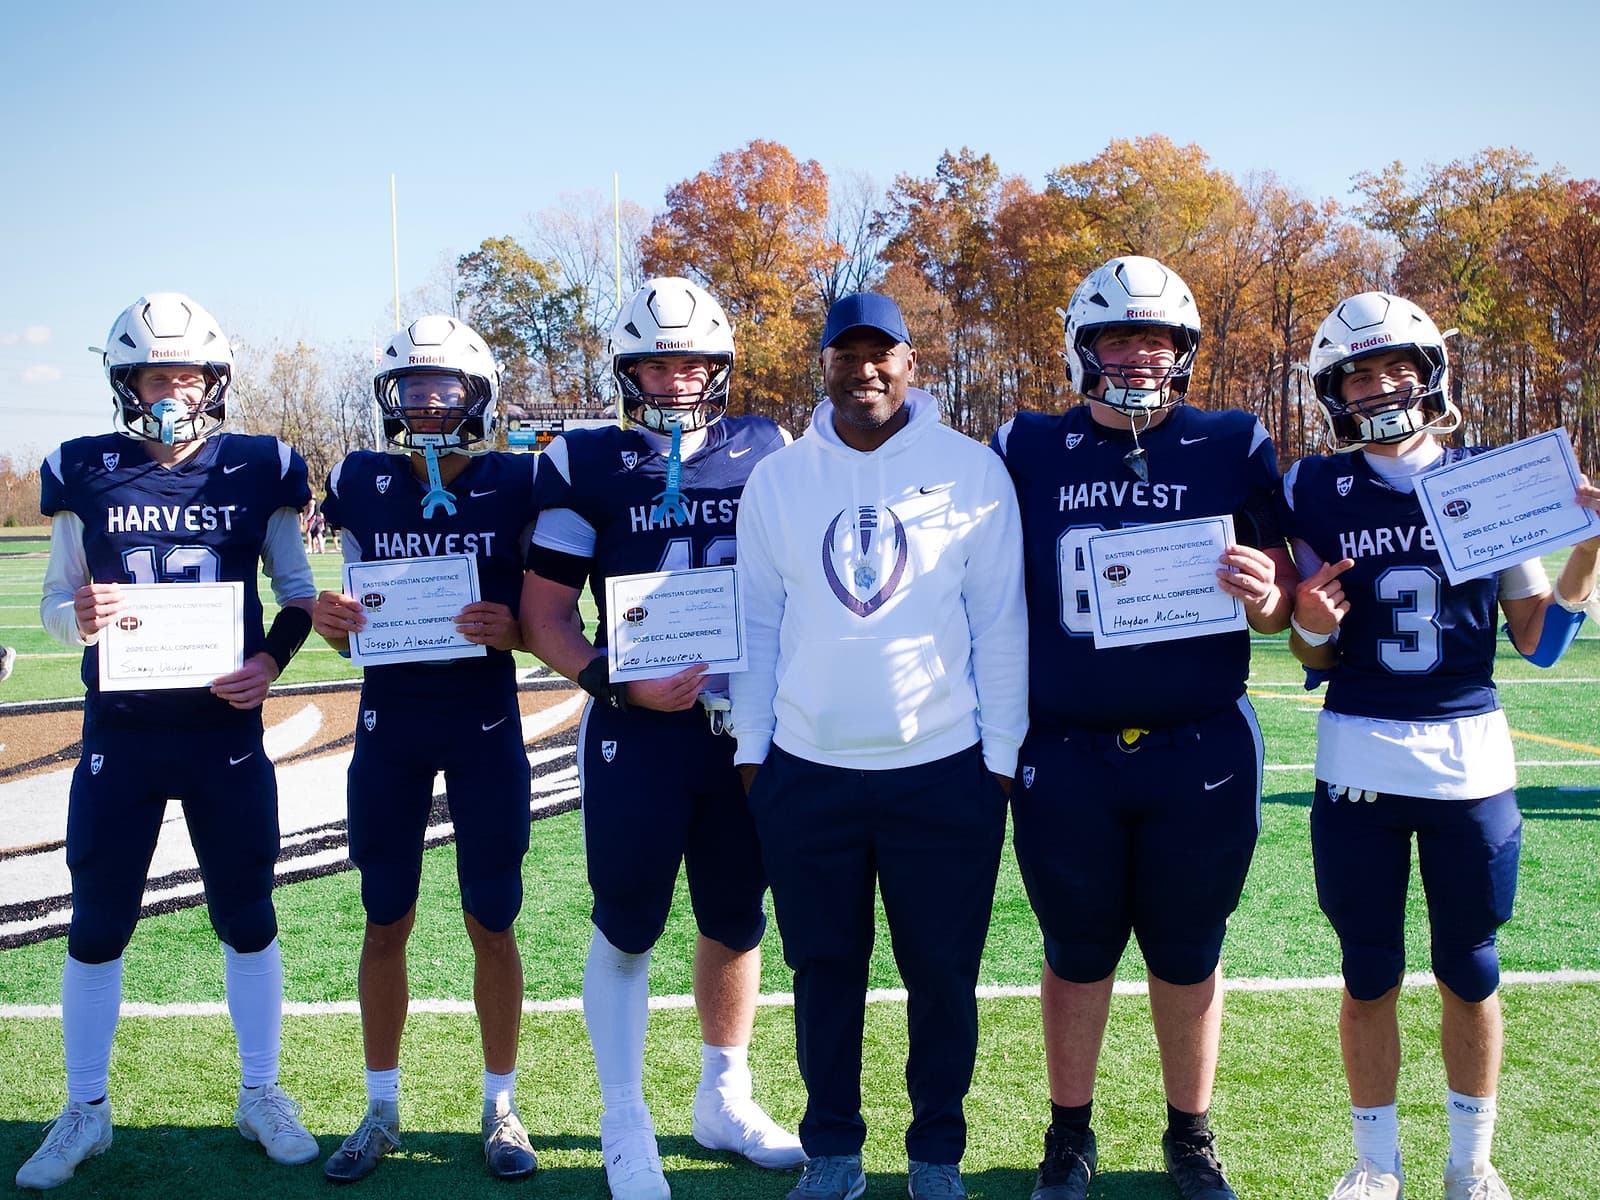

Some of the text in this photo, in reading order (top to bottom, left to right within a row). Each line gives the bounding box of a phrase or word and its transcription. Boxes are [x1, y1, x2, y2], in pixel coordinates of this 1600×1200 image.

[1127, 309, 1166, 318] Riddell
[656, 340, 693, 349] Riddell
[1351, 334, 1392, 351] Riddell
[151, 350, 190, 358] Riddell
[408, 356, 445, 364] Riddell
[1441, 482, 1472, 497] EASTERN
[1473, 471, 1507, 487] CHRISTIAN
[1507, 456, 1552, 476] CONFERENCE
[1058, 481, 1188, 512] HARVEST
[108, 504, 236, 533] HARVEST
[1462, 528, 1482, 539] 2025
[1482, 522, 1498, 533] ECC
[1499, 517, 1515, 528] ALL
[1514, 501, 1562, 522] CONFERENCE
[374, 532, 496, 557] HARVEST
[1105, 539, 1214, 561] EASTERN CHRISTIAN CONFERENCE
[362, 574, 459, 589] EASTERN CHRISTIAN CONFERENCE
[654, 591, 685, 600] CHRISTIAN
[685, 586, 724, 596] CONFERENCE
[1117, 597, 1135, 606] 2025
[1136, 595, 1151, 603] ECC
[1167, 586, 1215, 598] CONFERENCE
[372, 621, 389, 629] 2025
[1375, 565, 1443, 675] 3
[679, 628, 722, 639] CONFERENCE
[175, 643, 219, 651] CONFERENCE
[364, 635, 455, 650] Joseph Alexander
[623, 652, 640, 666] Leo
